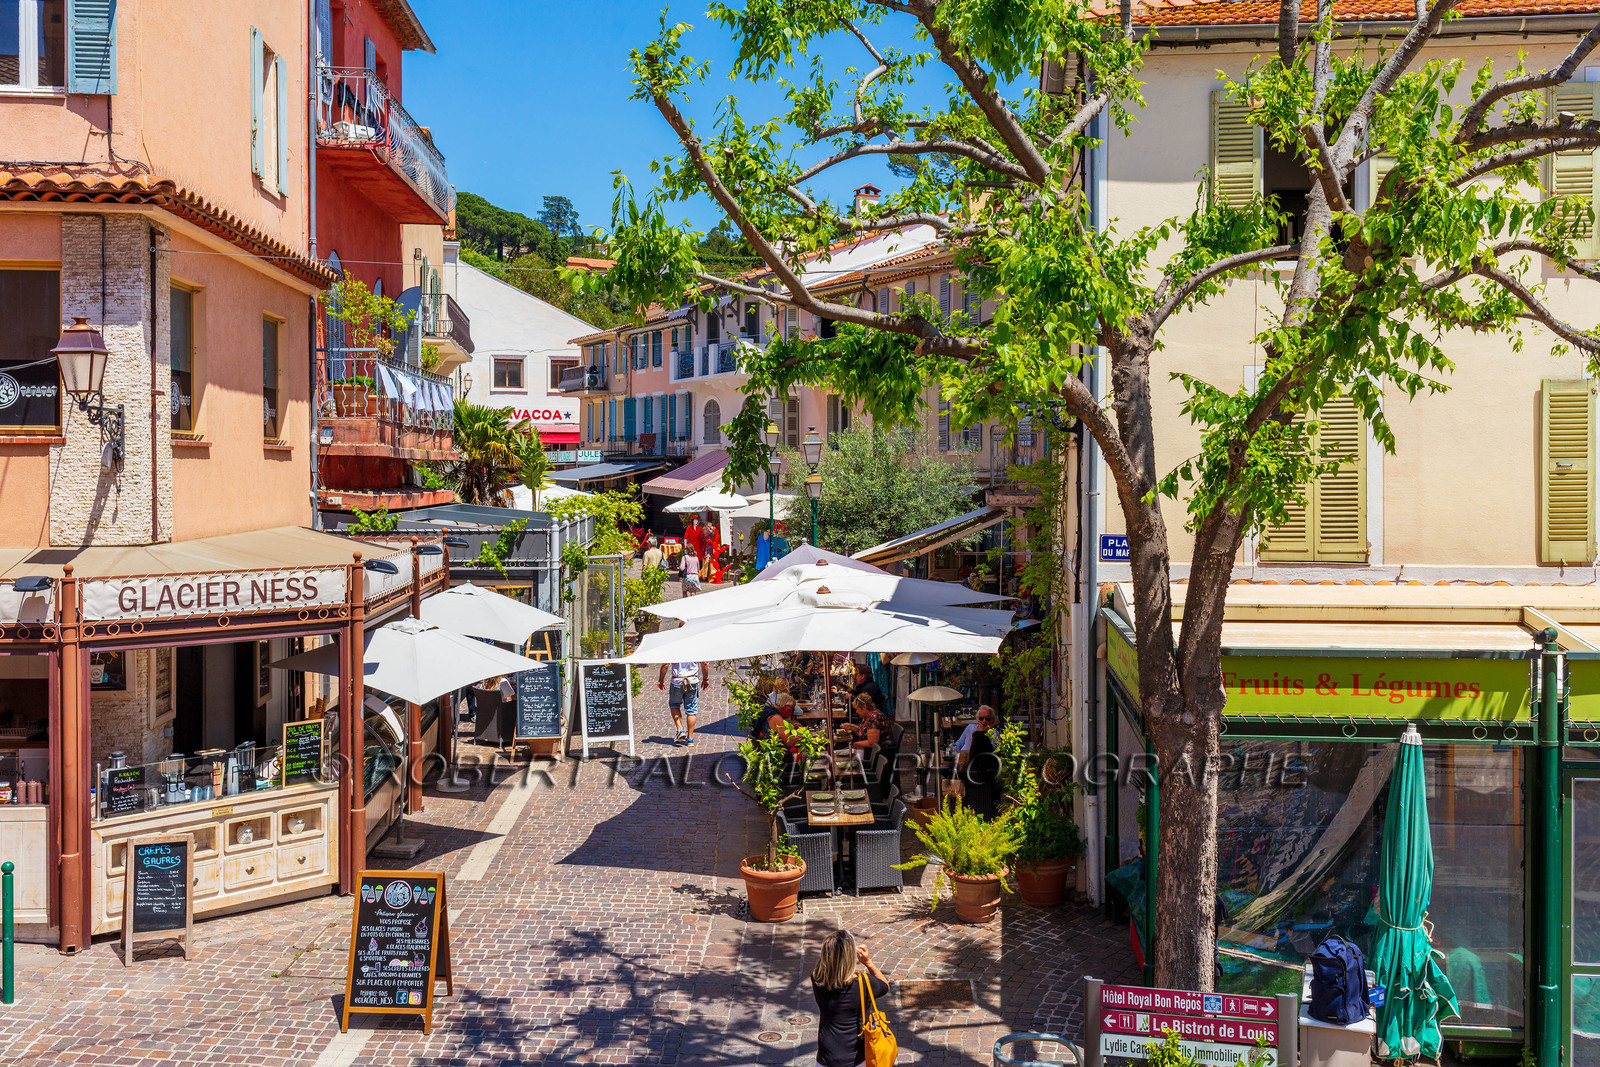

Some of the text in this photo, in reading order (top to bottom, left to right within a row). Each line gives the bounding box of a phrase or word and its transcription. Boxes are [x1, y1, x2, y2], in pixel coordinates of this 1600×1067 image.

[493, 408, 562, 420] VACOA
[578, 450, 604, 458] JULES
[1108, 538, 1128, 547] PLA
[1102, 548, 1130, 557] DU MAR
[118, 576, 318, 613] GLACIER NESS
[1221, 672, 1481, 704] Fruits & Légumes
[138, 844, 171, 856] CRÊPES
[142, 856, 181, 866] GAUFRES
[1102, 990, 1202, 1012] Hôtel Royal Bon Repos
[1153, 1018, 1274, 1041] Le Bistrot de Louis
[1104, 1038, 1127, 1054] Lydie
[1194, 1046, 1242, 1062] Immobilier
